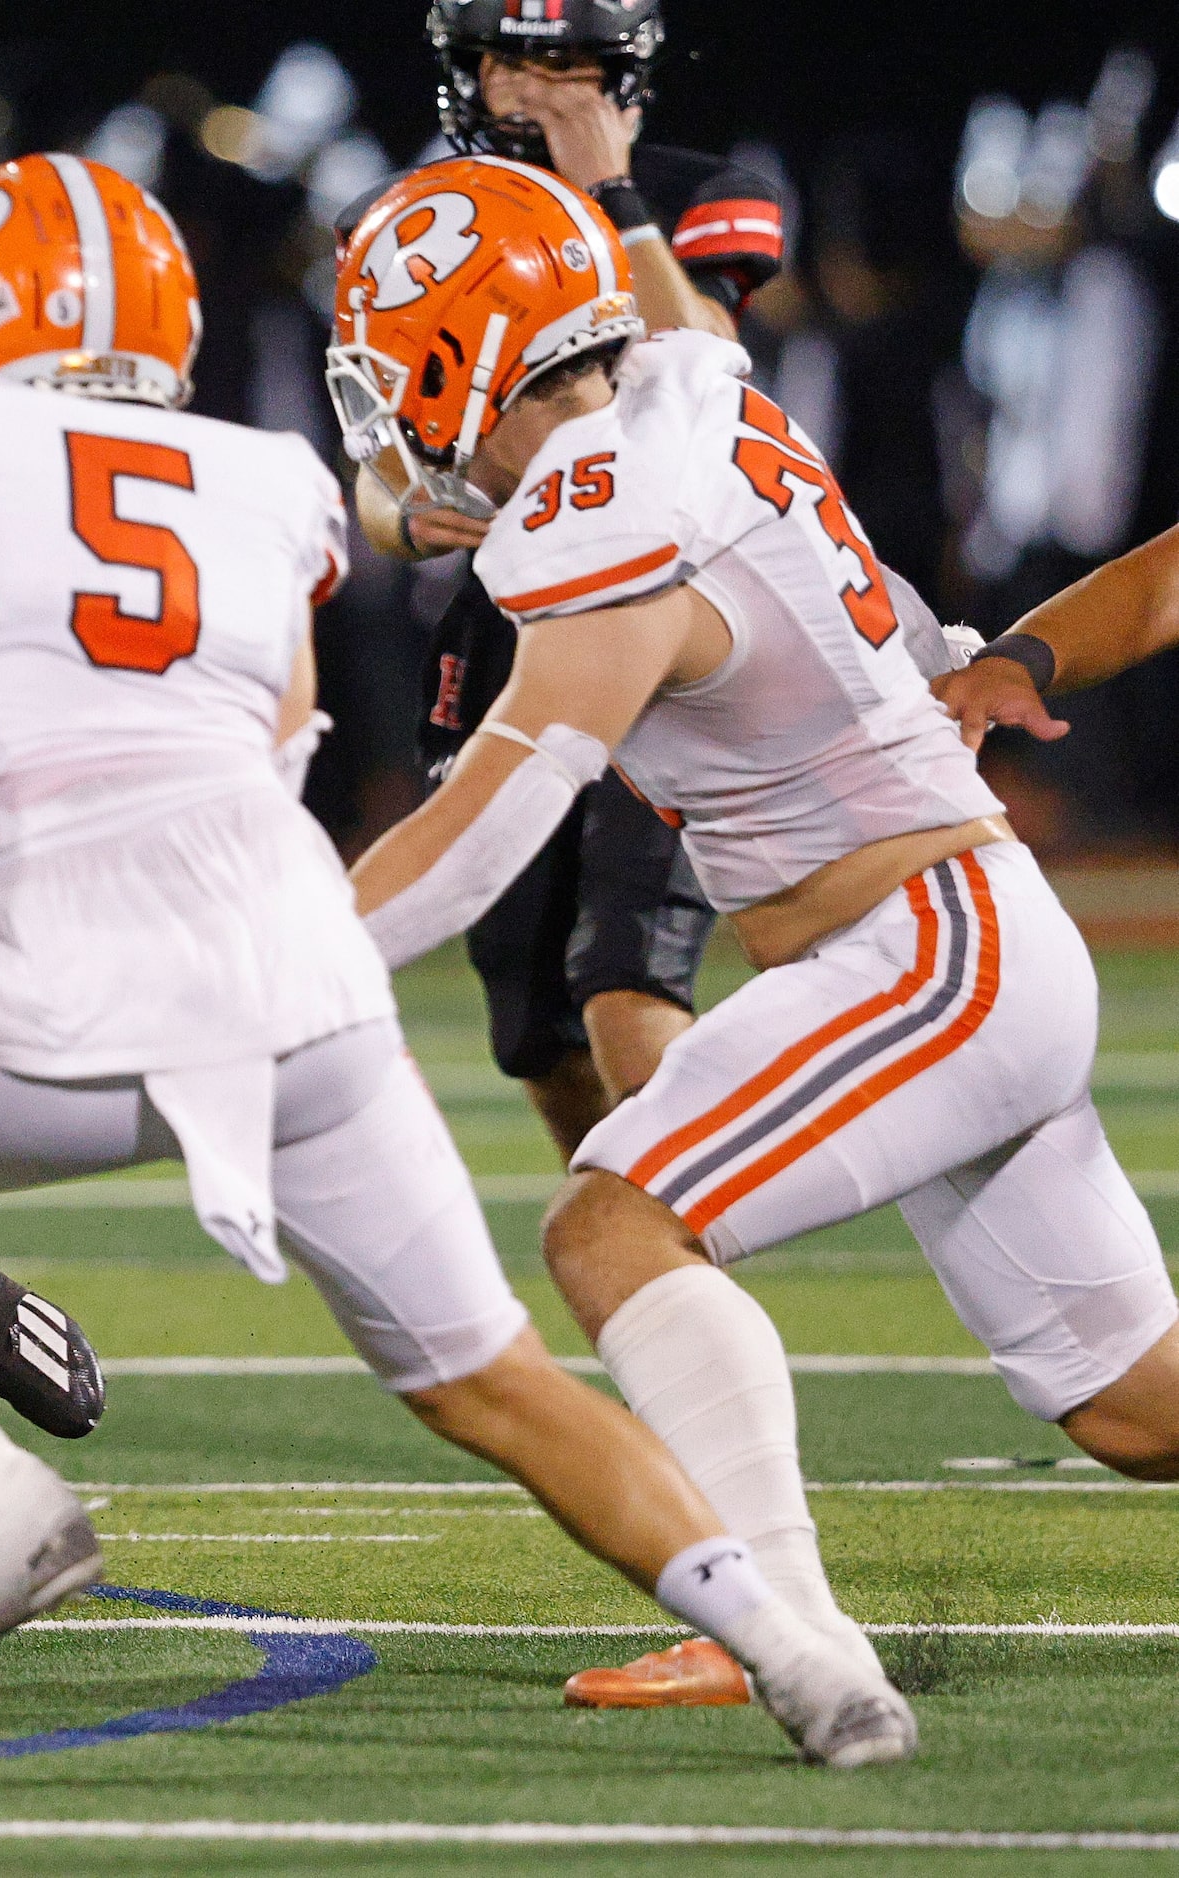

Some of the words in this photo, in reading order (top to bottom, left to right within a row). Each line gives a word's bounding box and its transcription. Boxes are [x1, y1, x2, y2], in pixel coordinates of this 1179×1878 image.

[359, 190, 482, 311] R
[563, 241, 586, 270] 35
[522, 452, 618, 532] 35
[63, 430, 202, 675] 5
